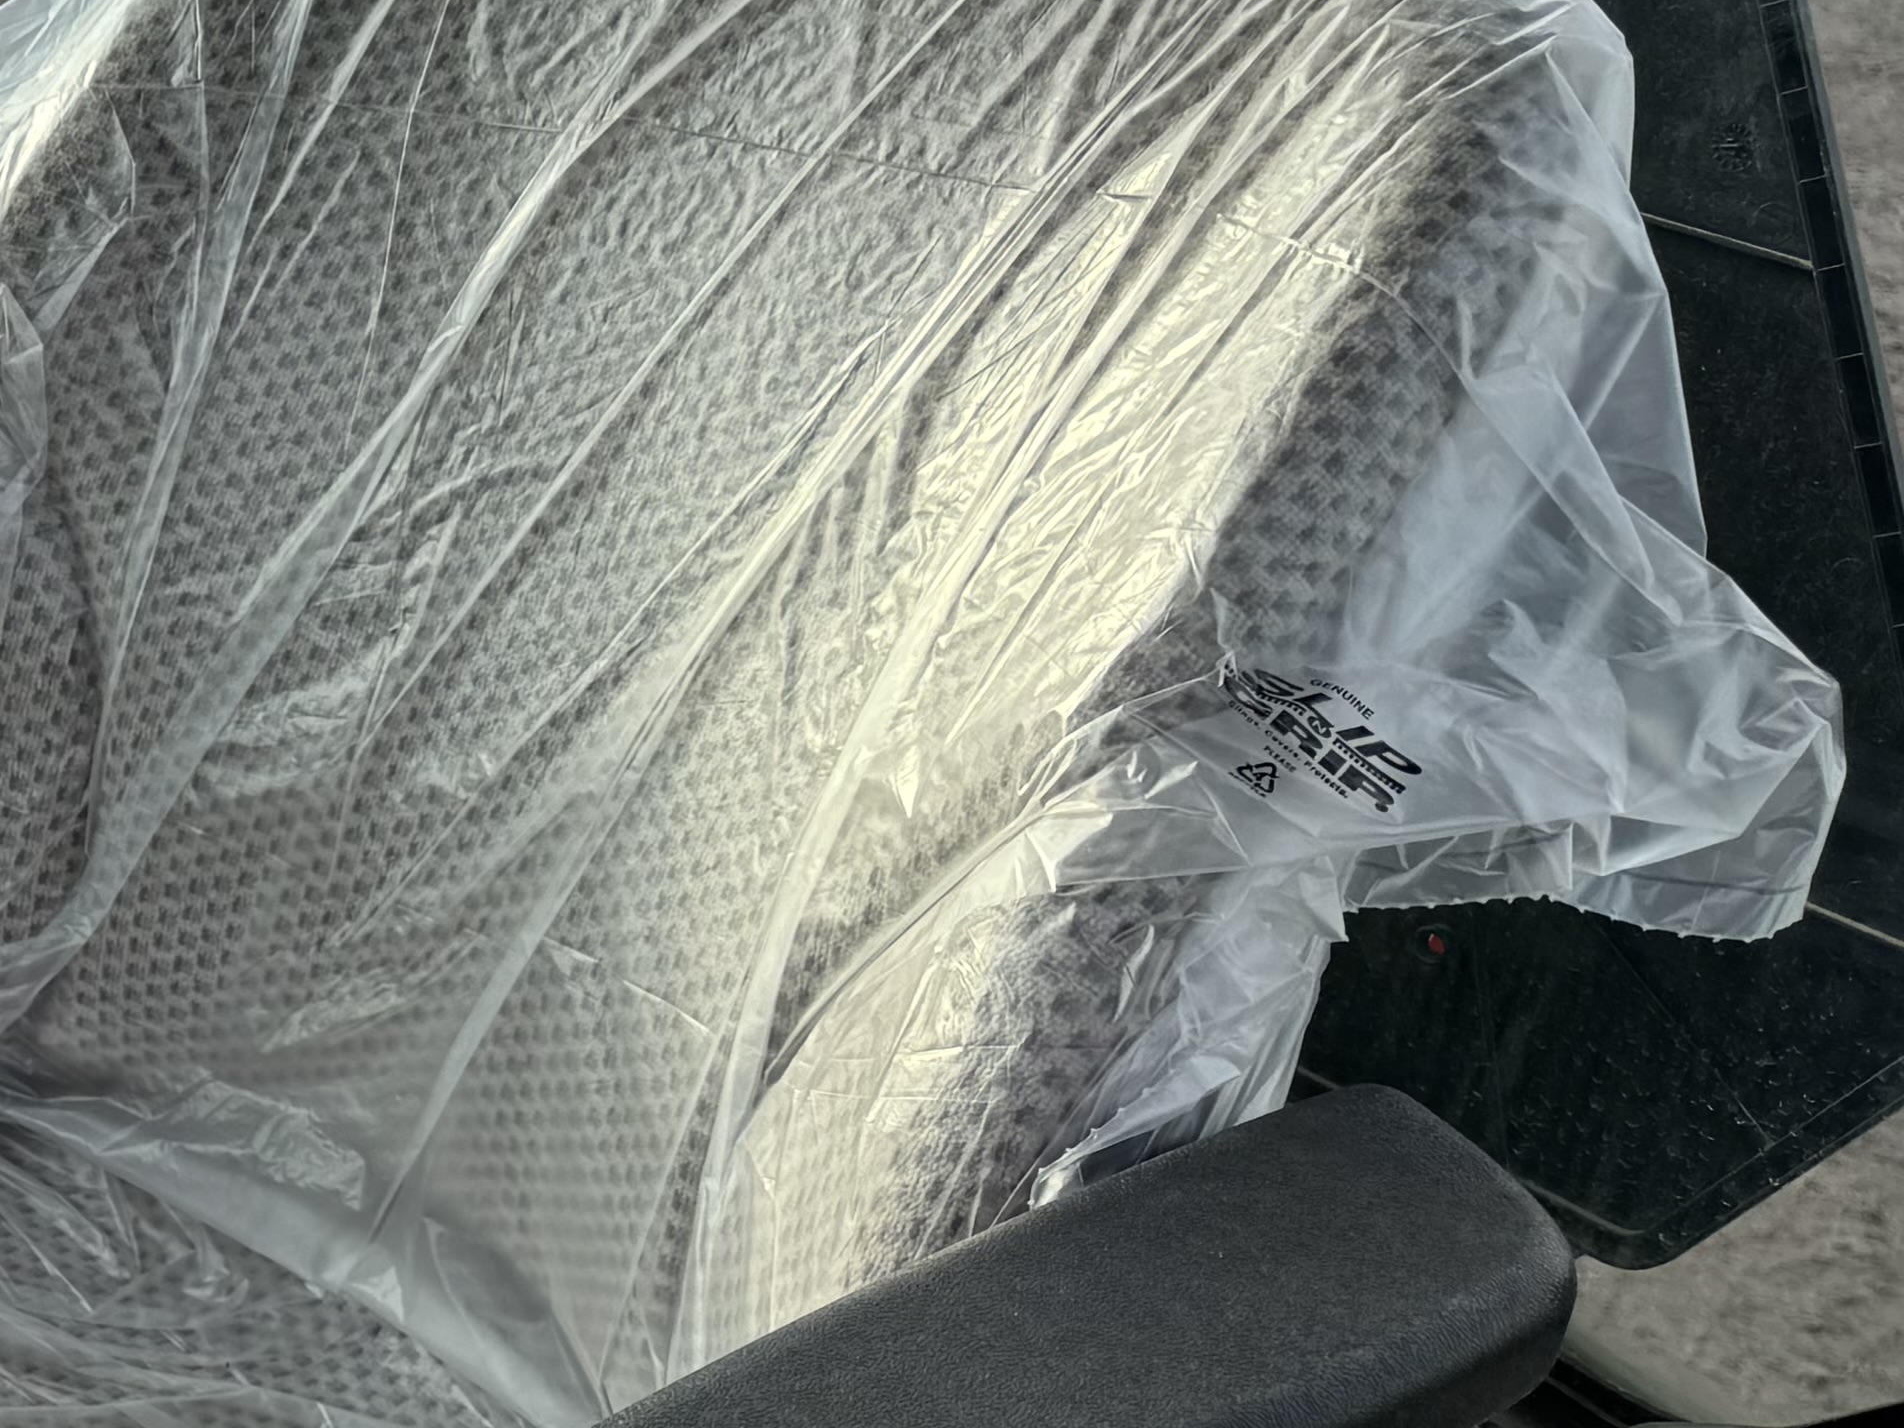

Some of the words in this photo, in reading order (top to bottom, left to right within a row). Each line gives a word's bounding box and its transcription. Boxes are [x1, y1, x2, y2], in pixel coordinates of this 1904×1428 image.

[1310, 678, 1375, 721] GENUINE
[1240, 669, 1423, 775] SLIP
[1263, 744, 1297, 773] PLEASE
